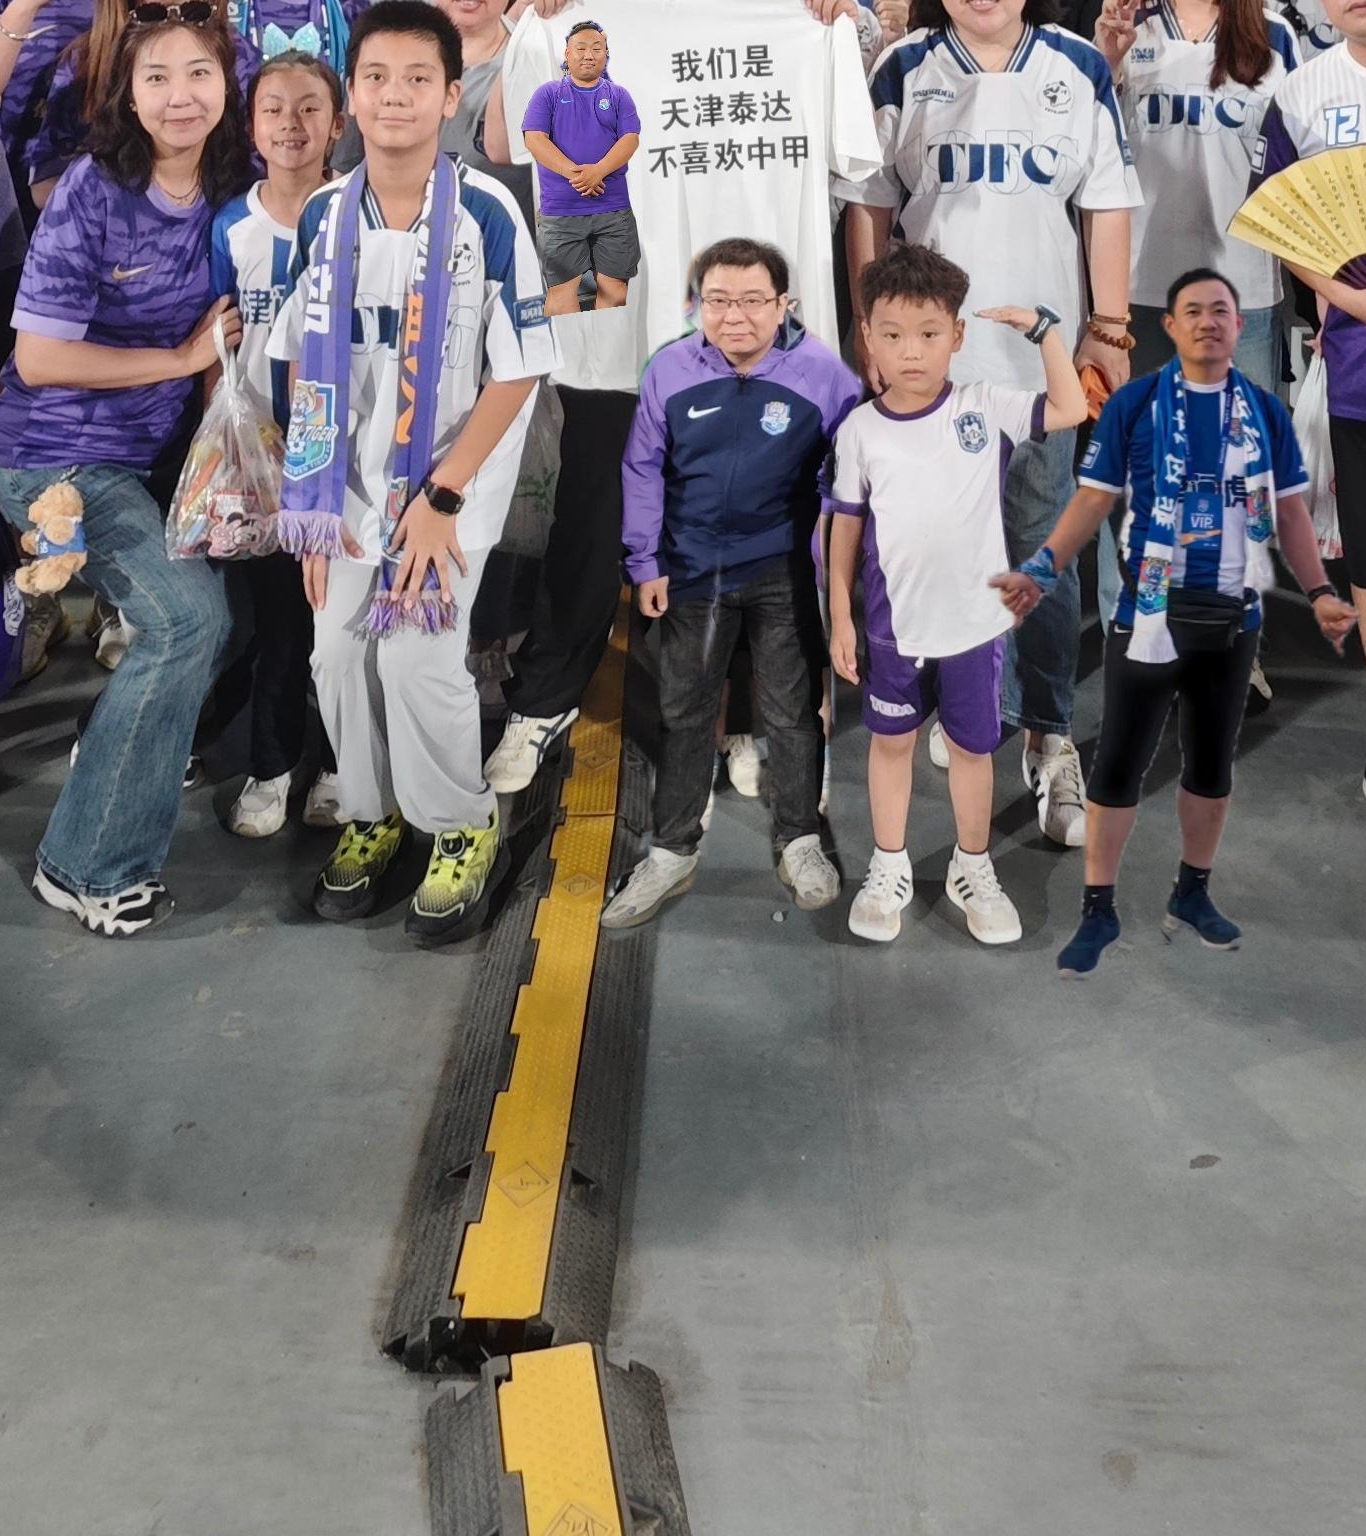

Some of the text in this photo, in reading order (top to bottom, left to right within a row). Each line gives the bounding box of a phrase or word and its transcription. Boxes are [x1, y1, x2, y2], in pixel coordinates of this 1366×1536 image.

[671, 44, 774, 83] 我们是
[660, 89, 793, 131] 天津泰达
[1323, 104, 1361, 147] 12
[647, 135, 810, 179] 不喜欢中甲
[926, 142, 1059, 186] TJFC
